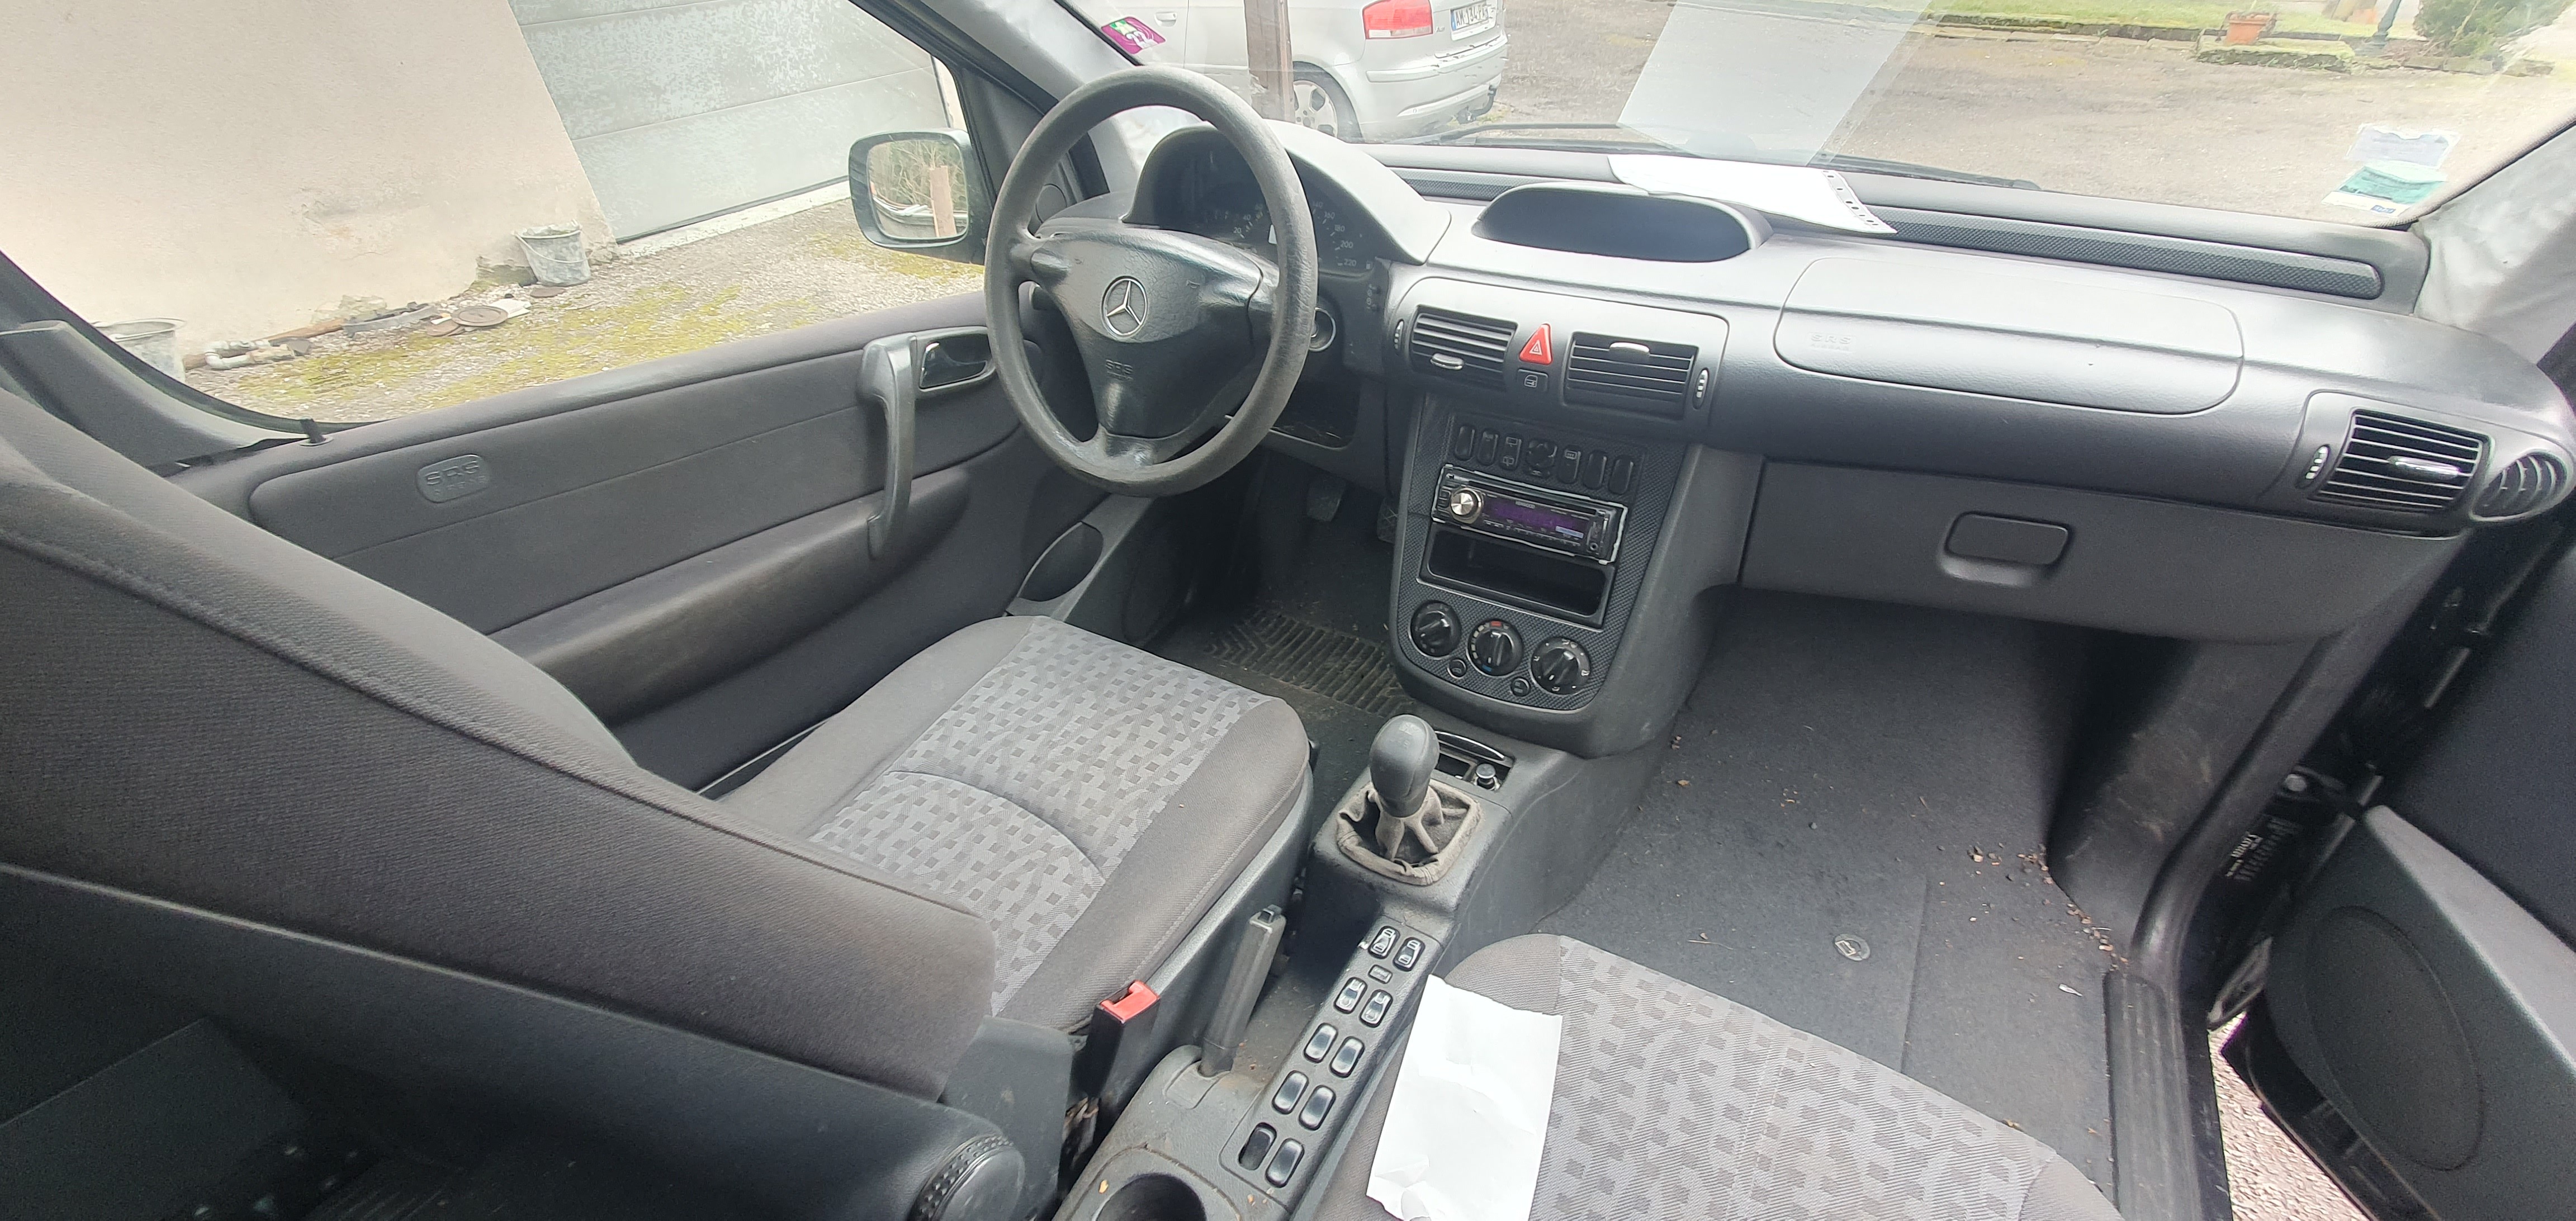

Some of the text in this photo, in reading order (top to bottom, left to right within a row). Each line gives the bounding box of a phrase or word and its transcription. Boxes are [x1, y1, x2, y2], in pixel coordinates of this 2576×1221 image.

[1340, 240, 1353, 248] 200
[1344, 258, 1357, 267] 220
[1811, 334, 1851, 344] SRS
[1105, 358, 1133, 373] SRS
[424, 460, 480, 486] SRS
